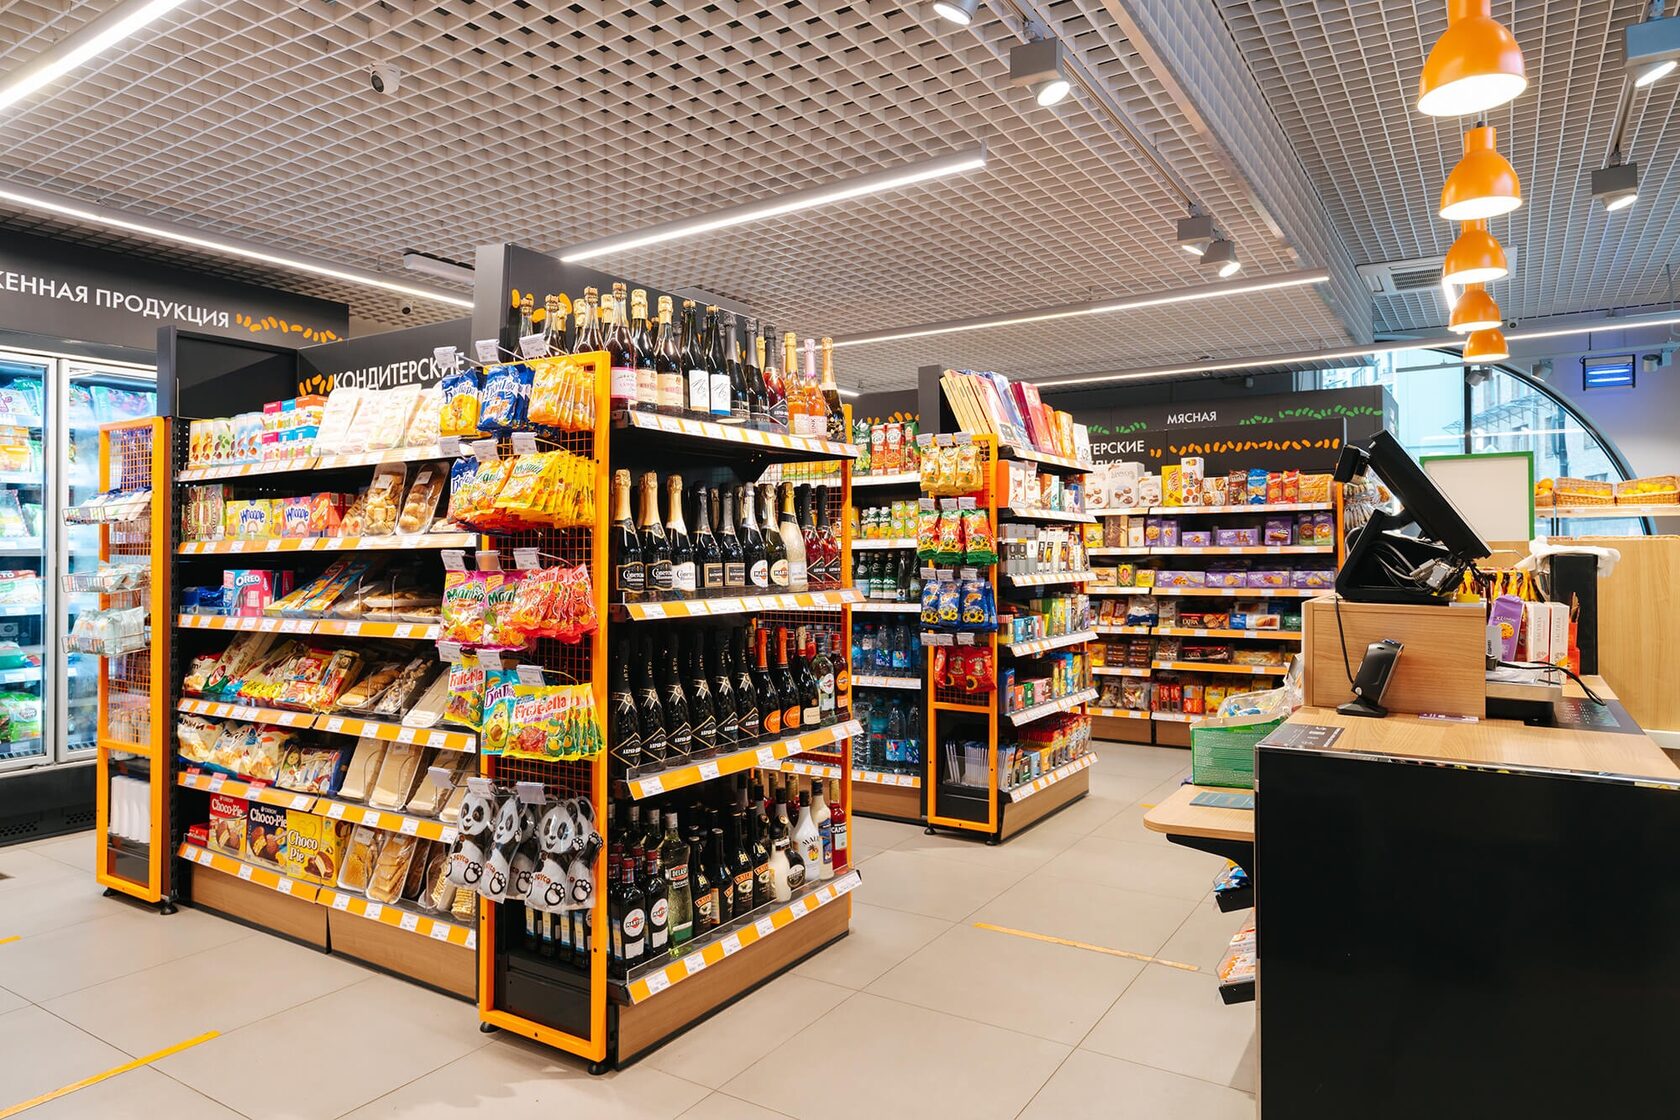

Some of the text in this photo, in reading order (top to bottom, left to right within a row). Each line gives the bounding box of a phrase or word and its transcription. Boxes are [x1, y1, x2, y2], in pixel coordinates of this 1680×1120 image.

[95, 288, 230, 328] ПРОДУКЦИЯ
[1166, 410, 1217, 424] МЯСНАЯ
[235, 575, 261, 587] OREO
[211, 798, 244, 818] Choco-Pie
[249, 807, 287, 828] Choco-Pie
[287, 829, 319, 850] Choco
[288, 846, 305, 864] Pie
